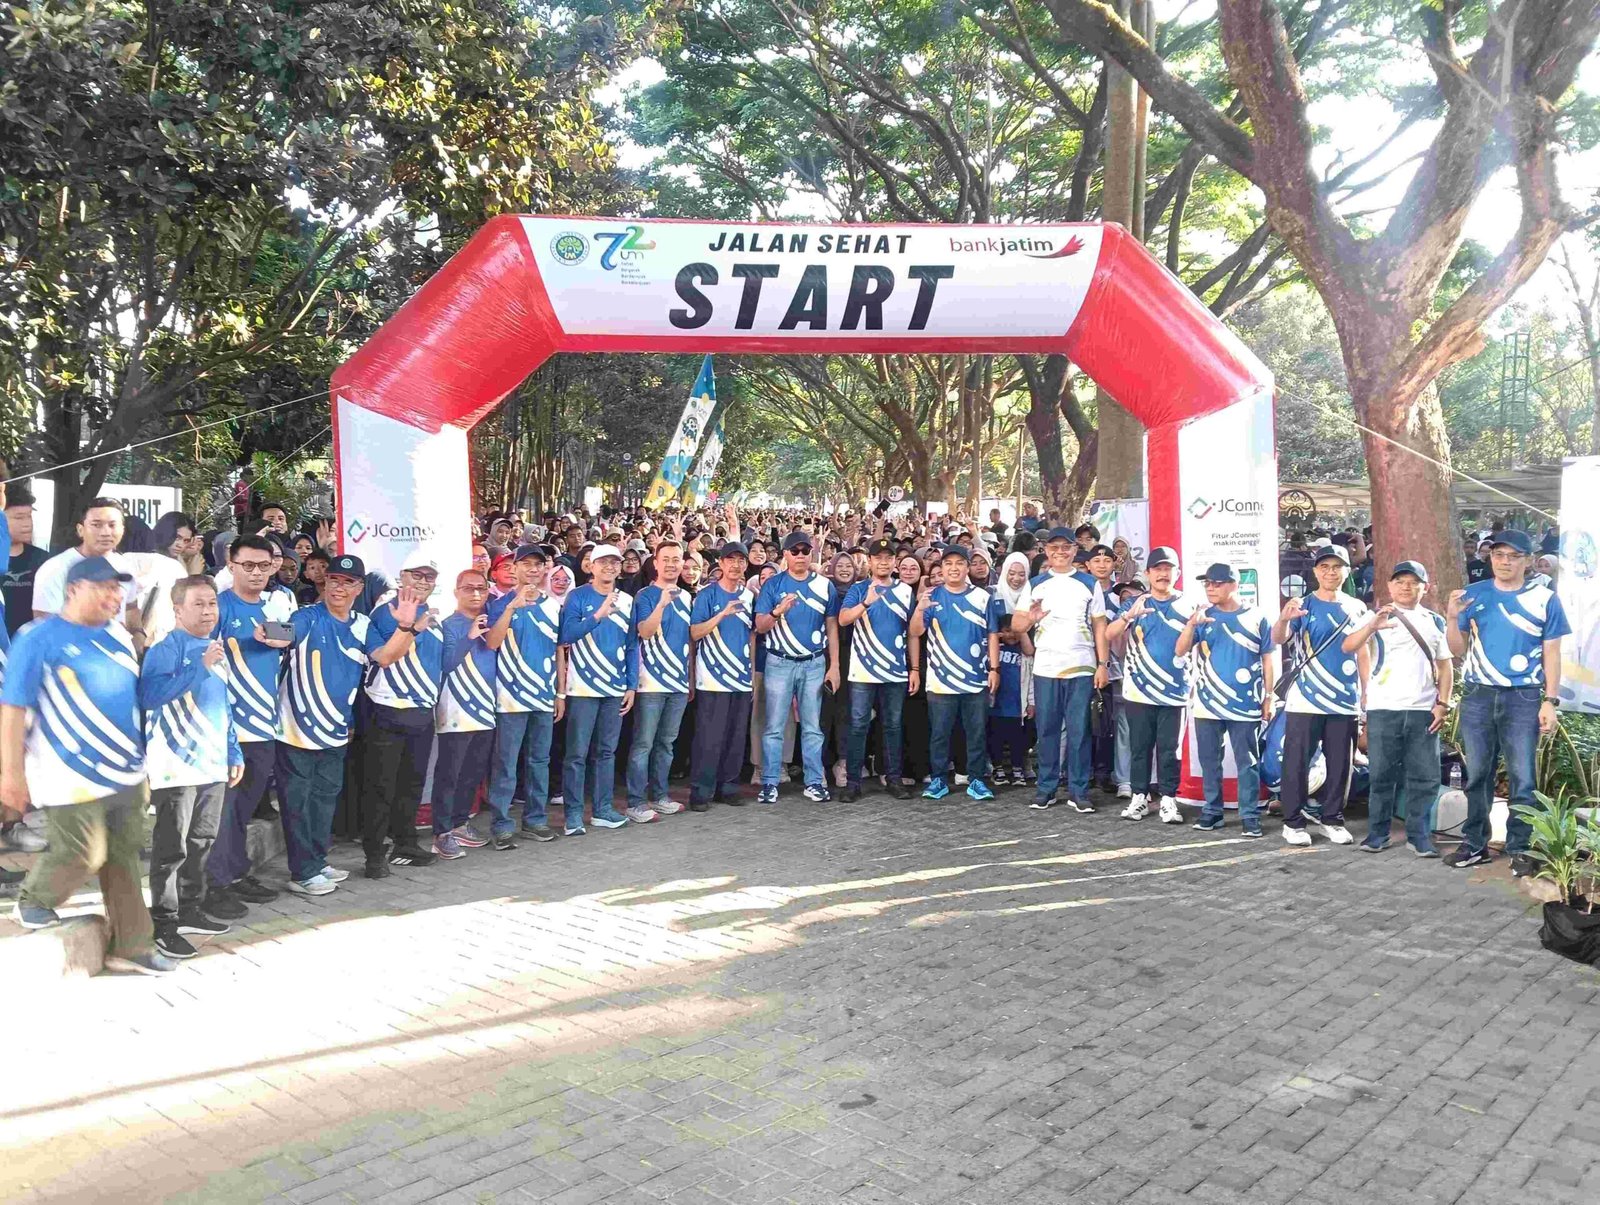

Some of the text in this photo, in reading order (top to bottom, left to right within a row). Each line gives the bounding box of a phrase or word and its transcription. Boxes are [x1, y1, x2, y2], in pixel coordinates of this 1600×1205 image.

[709, 232, 912, 254] JALAN SEHAT
[950, 237, 1053, 255] bankjatim
[669, 262, 955, 330] START
[1130, 547, 1144, 560] 2
